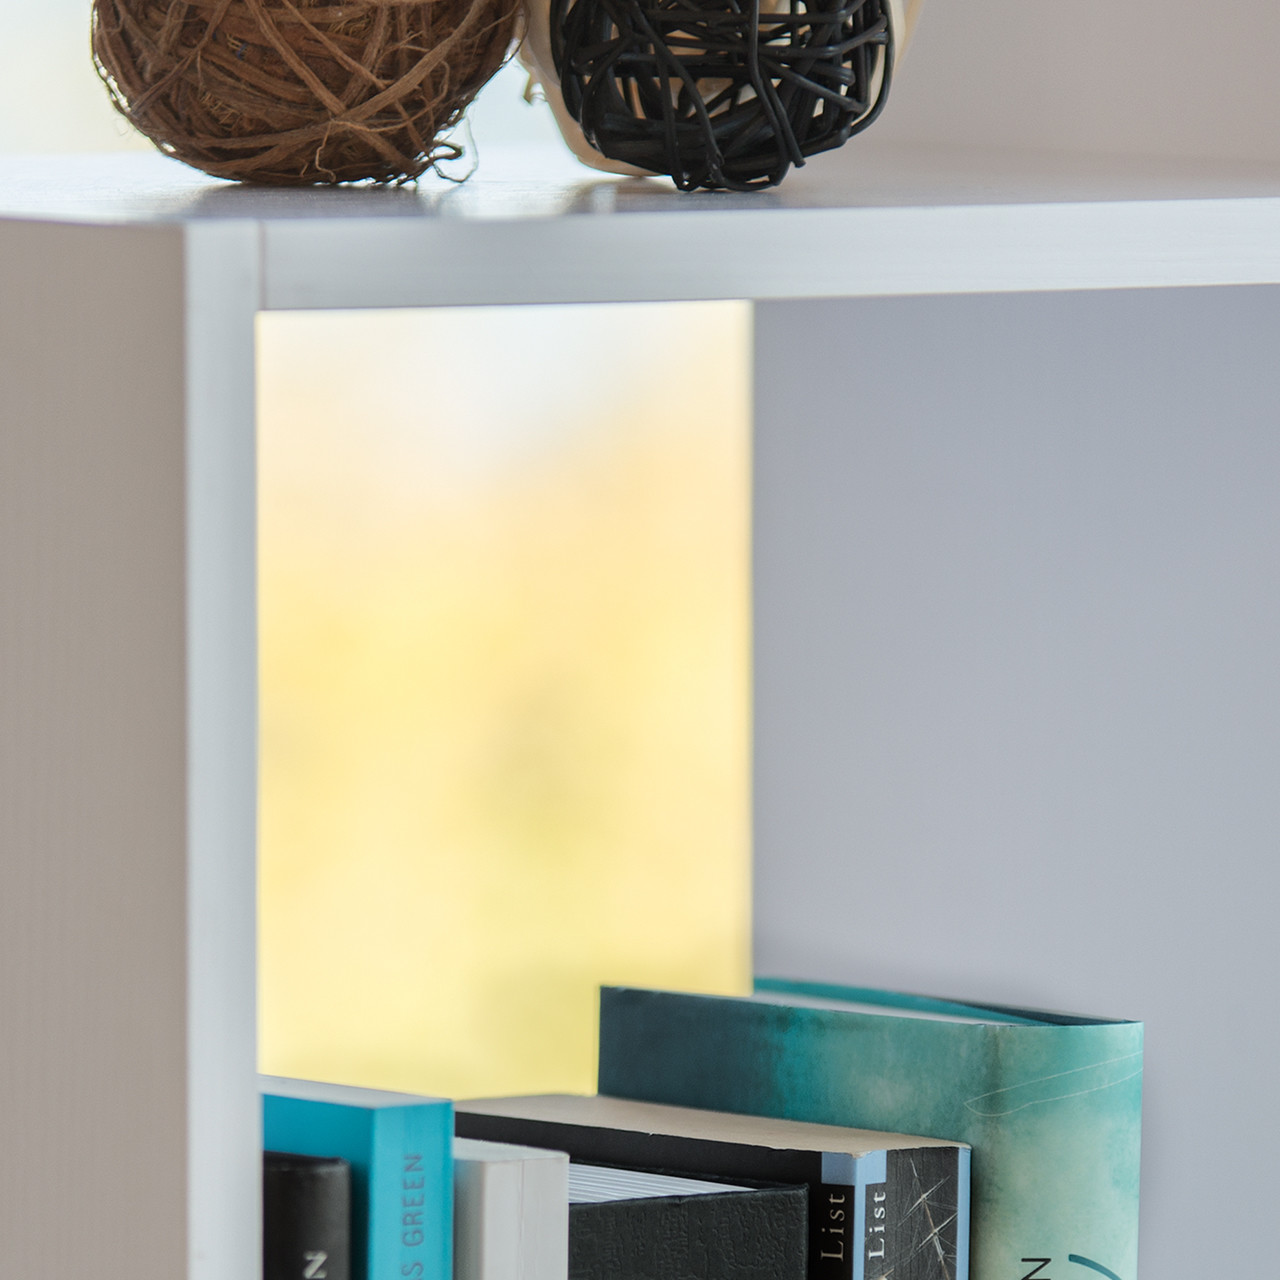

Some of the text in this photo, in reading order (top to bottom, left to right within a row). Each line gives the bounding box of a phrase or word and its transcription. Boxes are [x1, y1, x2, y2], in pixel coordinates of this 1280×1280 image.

[401, 1153, 423, 1247] GREEN
[821, 1193, 846, 1262] List
[868, 1190, 886, 1260] List
